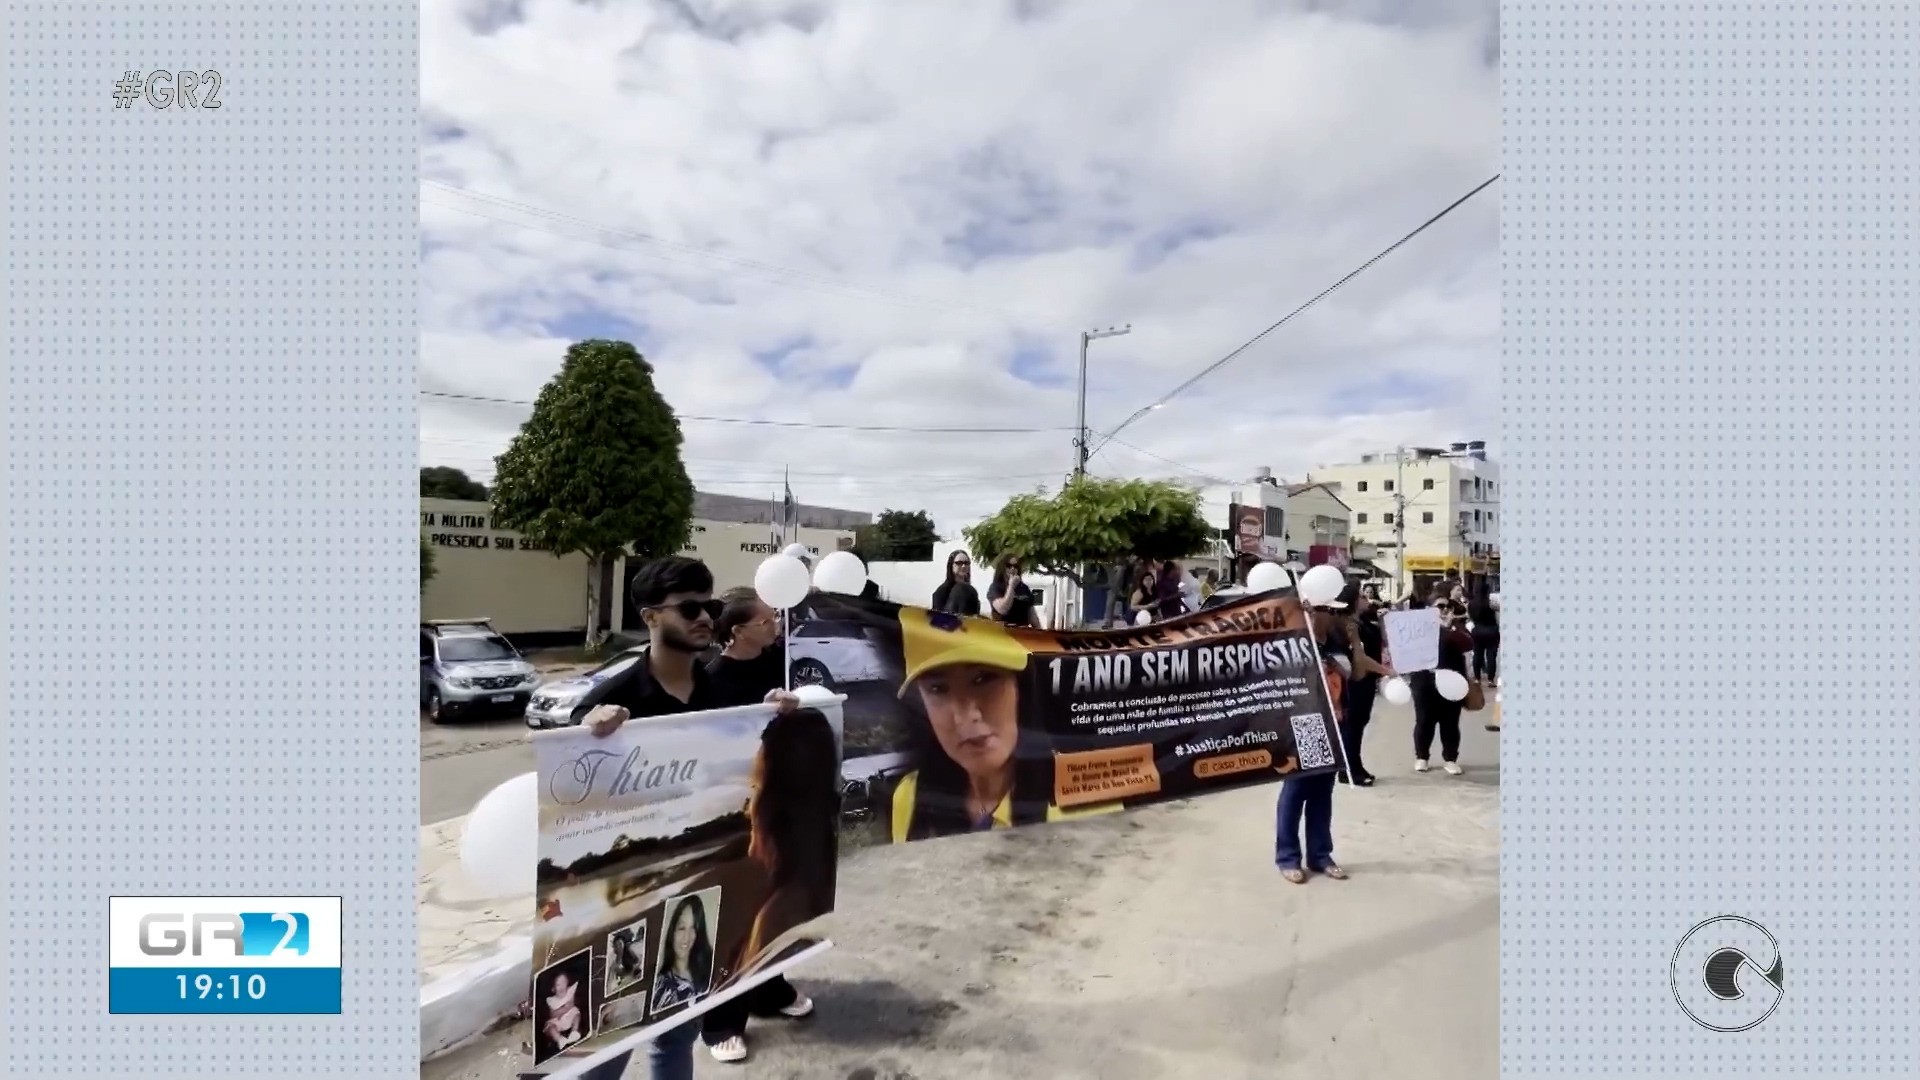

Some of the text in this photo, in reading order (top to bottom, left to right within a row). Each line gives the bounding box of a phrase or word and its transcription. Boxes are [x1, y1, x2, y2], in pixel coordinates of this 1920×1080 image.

[442, 514, 484, 528] MILITAR
[1177, 606, 1287, 640] TRÁGICA
[1049, 636, 1315, 694] 1 ANO SEM RESPOSTAS
[1071, 701, 1117, 712] Cobramos
[1125, 696, 1167, 708] conclusão
[1179, 691, 1211, 703] processo
[1212, 688, 1231, 697] sobre
[1071, 715, 1091, 725] vida
[1092, 713, 1105, 723] de
[1106, 712, 1125, 721] uma
[1127, 709, 1145, 719] mãe
[1191, 700, 1223, 711] caminho
[1097, 722, 1136, 735] sequelas
[1137, 718, 1179, 733] profundas
[1174, 731, 1279, 757] #JustiçaPorThiara
[550, 745, 698, 805] Thiara
[1212, 755, 1266, 771] caso_thiara
